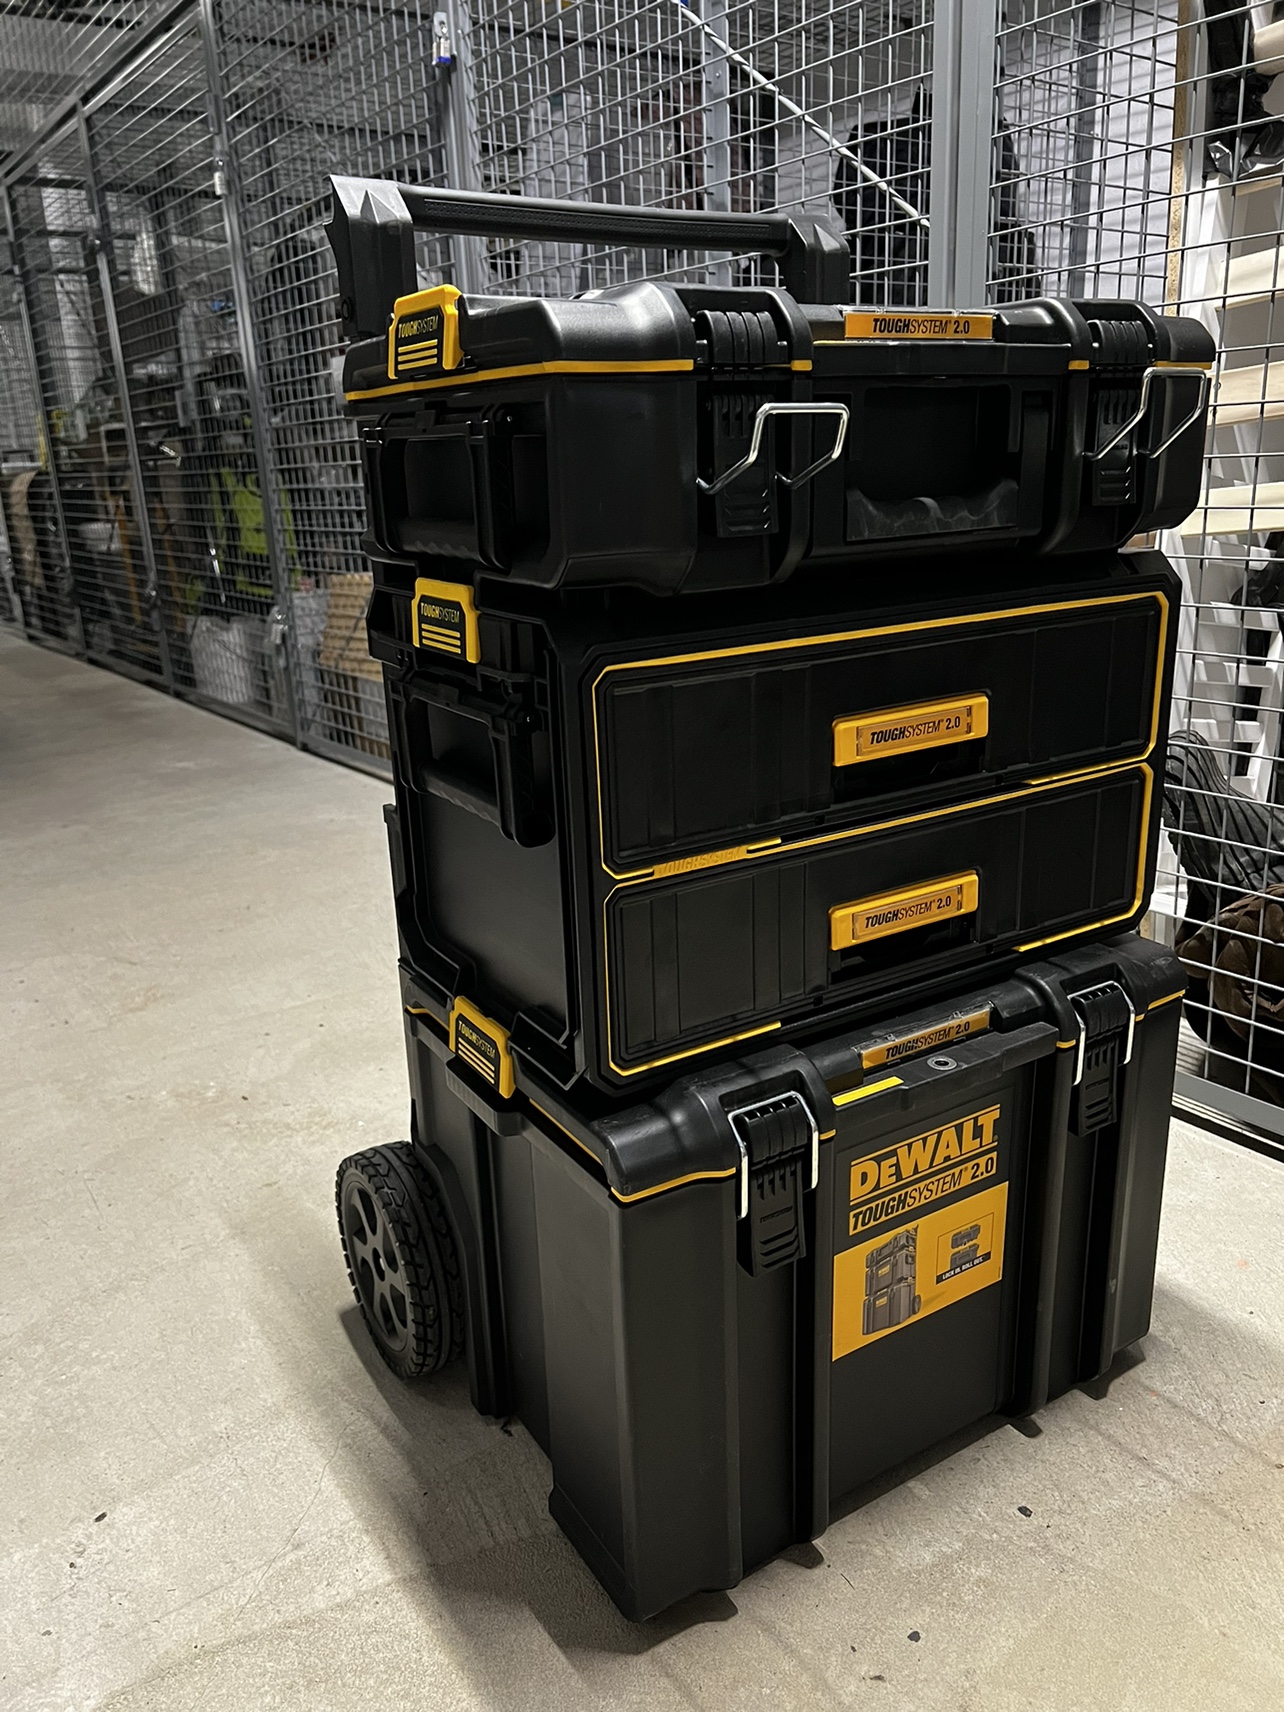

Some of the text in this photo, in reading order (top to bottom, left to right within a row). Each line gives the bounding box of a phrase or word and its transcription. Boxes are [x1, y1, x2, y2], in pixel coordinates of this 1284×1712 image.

[398, 315, 439, 338] TOUGHSYSTEM
[953, 320, 970, 334] 2.0
[420, 602, 460, 623] TOUGHSYSTEM
[945, 716, 961, 730] 2.0
[936, 895, 952, 910] 2.0
[955, 1021, 970, 1035] 2.0
[458, 1020, 496, 1059] TOUGHSYSTEM
[970, 1156, 994, 1181] 2.0
